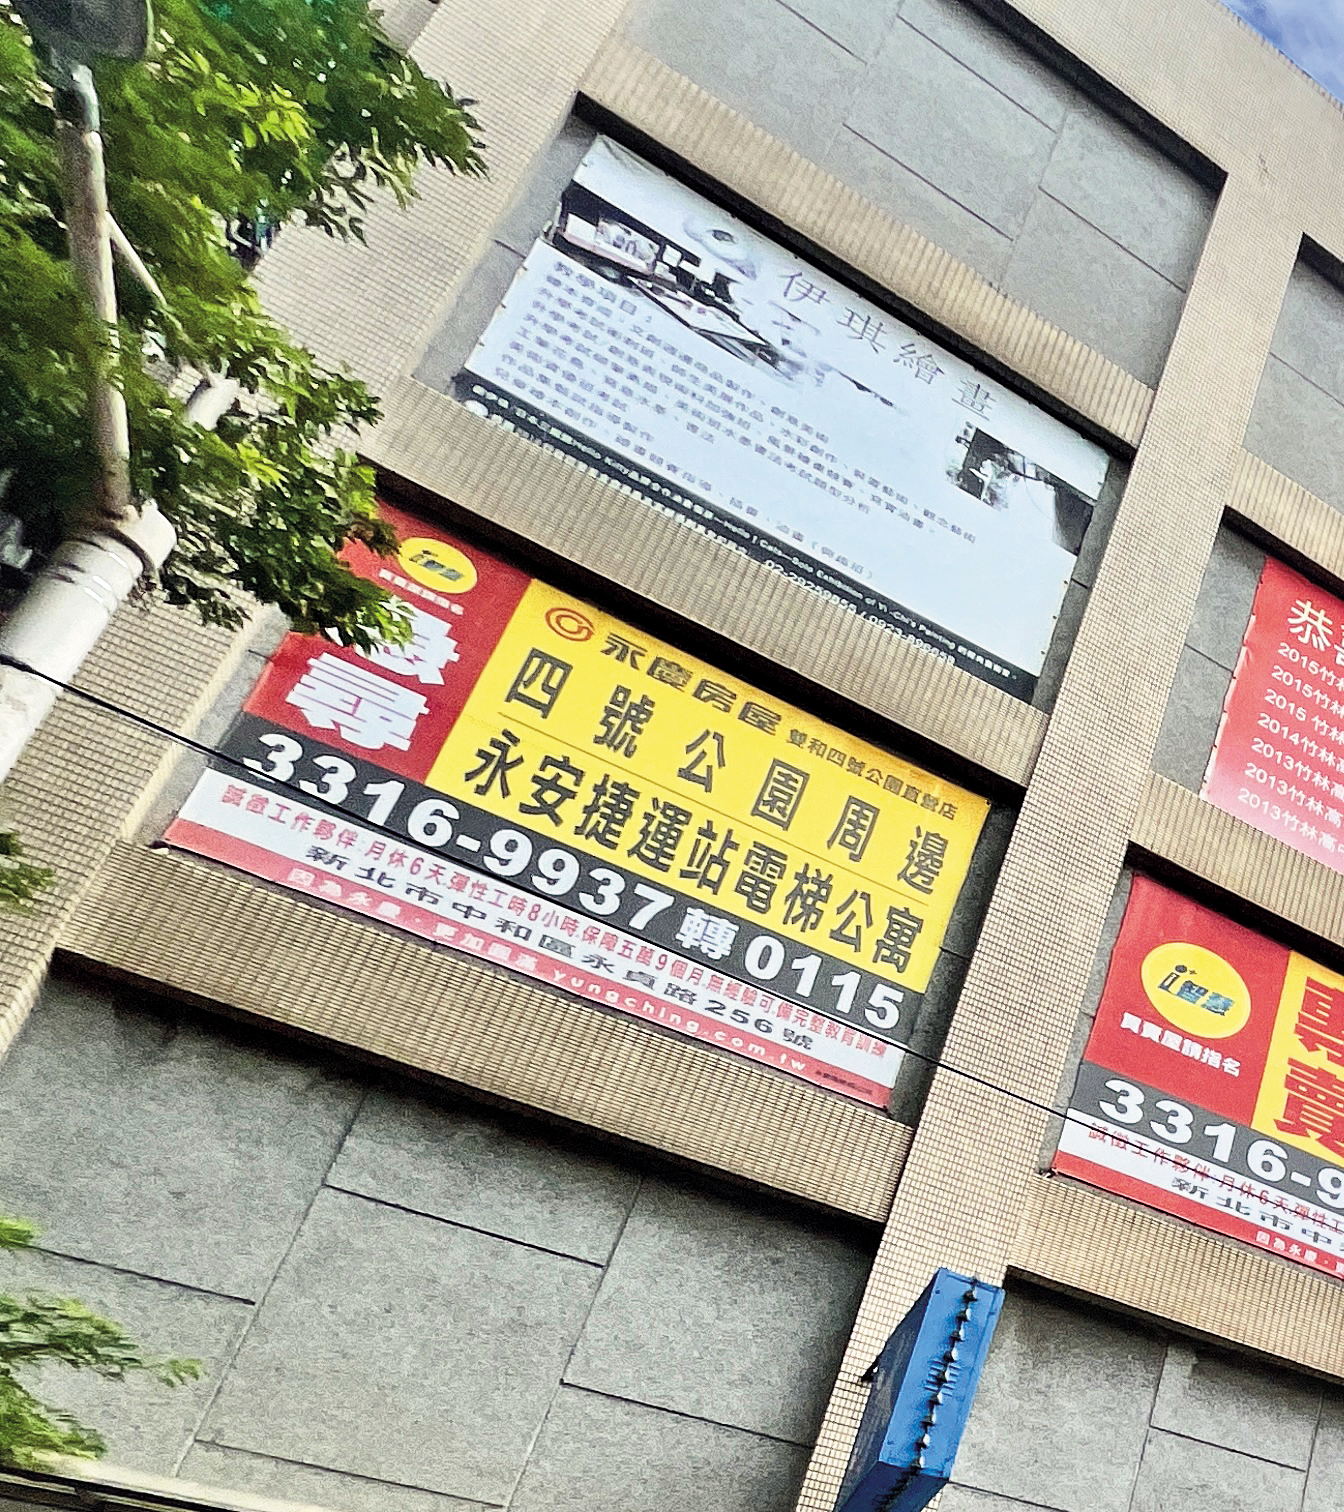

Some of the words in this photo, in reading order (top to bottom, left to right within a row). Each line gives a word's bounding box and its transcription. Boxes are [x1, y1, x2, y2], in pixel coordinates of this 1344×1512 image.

[773, 262, 998, 424] 伊琪繪畫
[501, 643, 950, 896] 四號公園周邊
[598, 631, 783, 737] 永慶房屋
[785, 726, 958, 822] 雙和四號公園直營店
[455, 722, 927, 976] 永安捷運站電梯公寓
[547, 966, 807, 1077] yungching.com.tw
